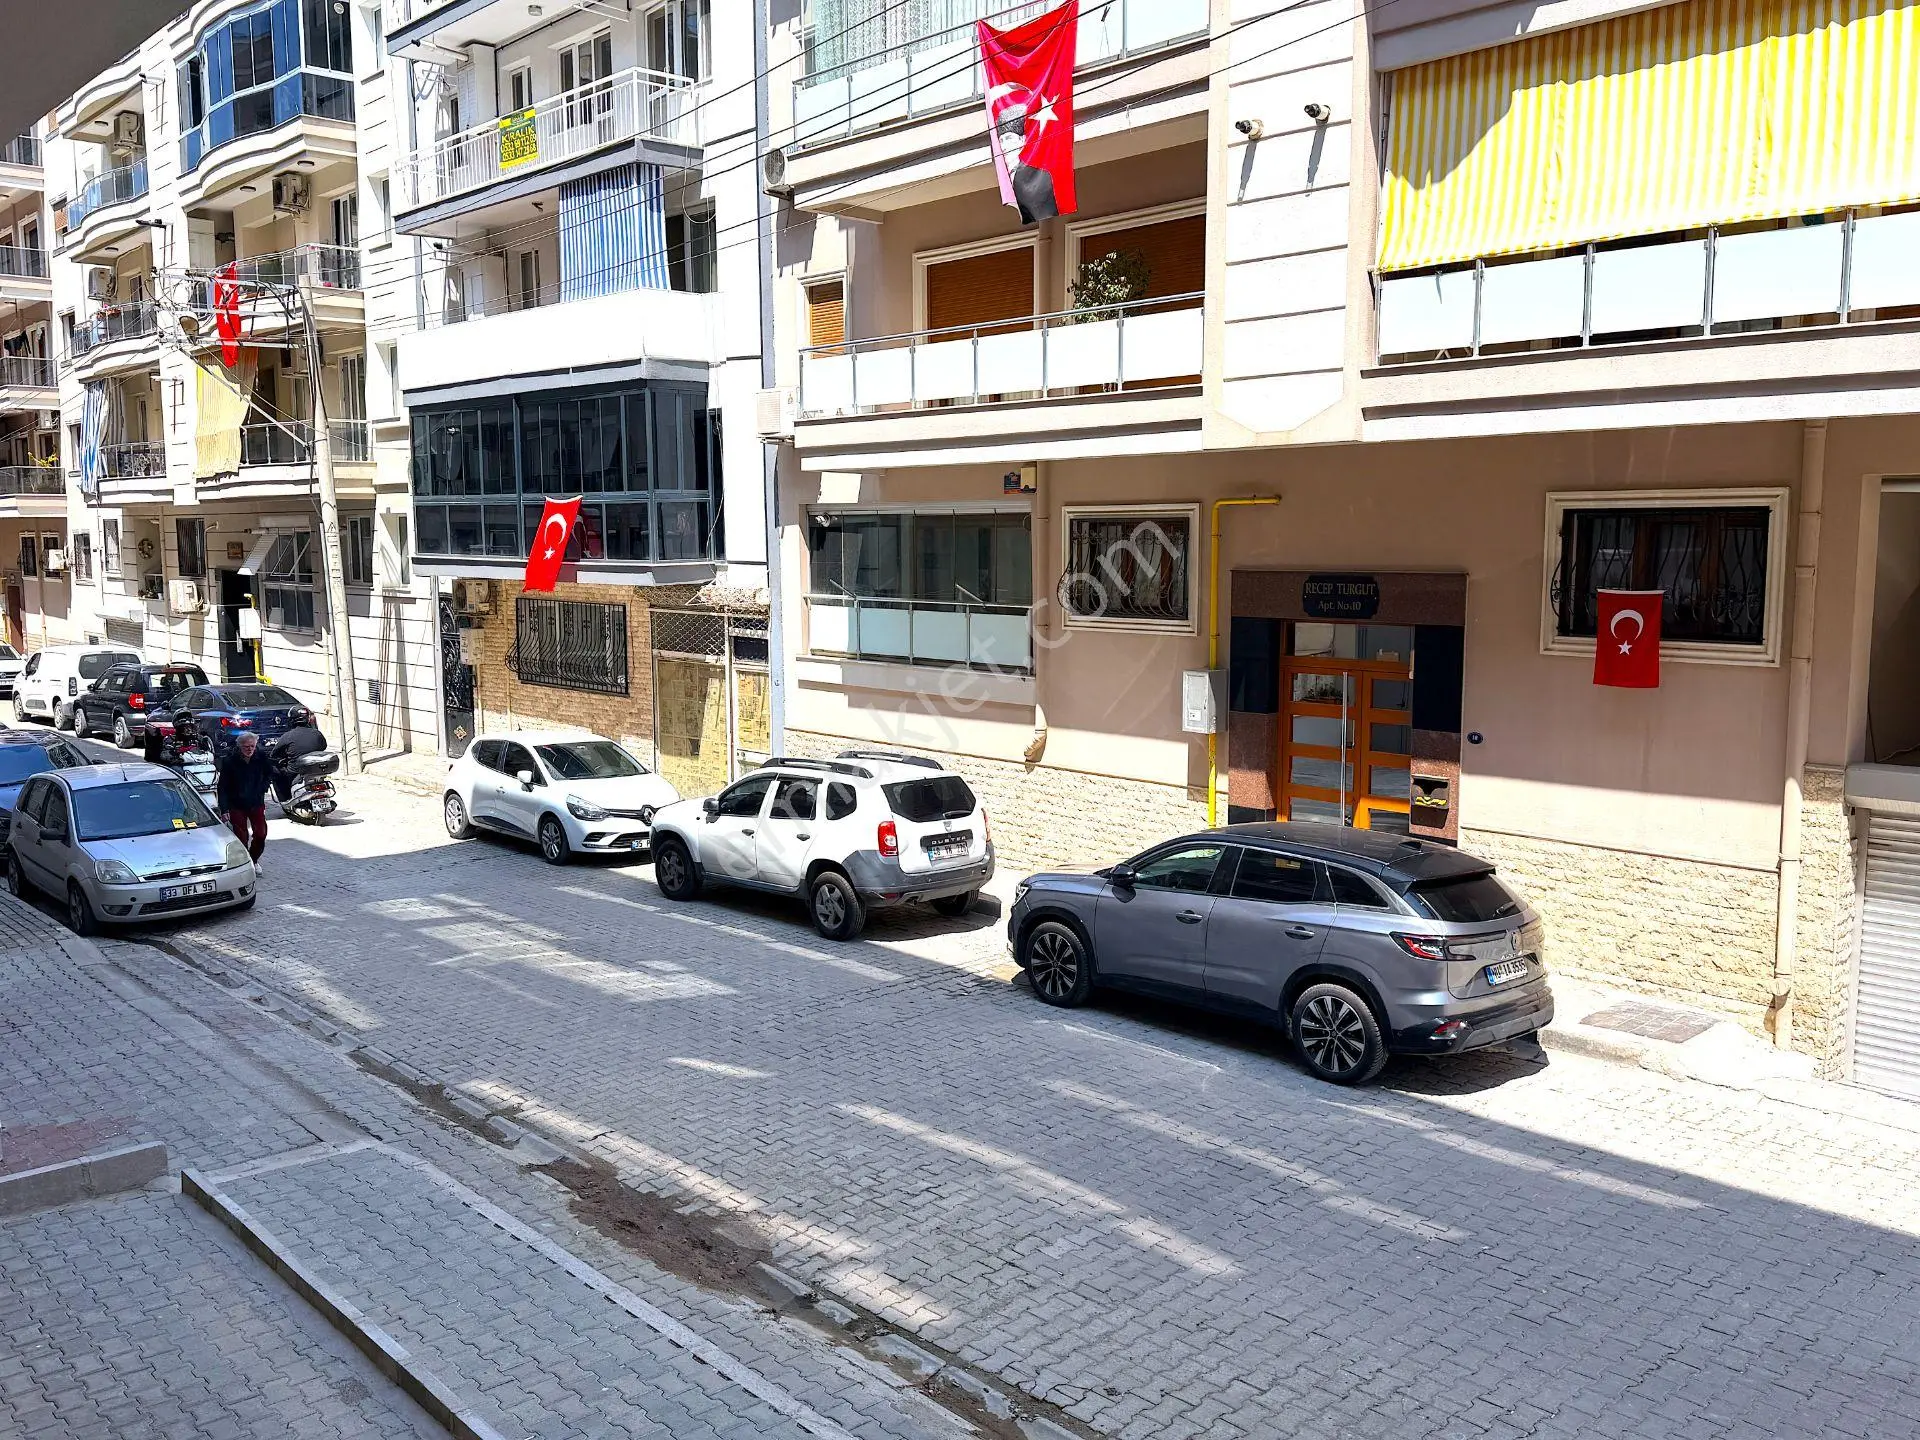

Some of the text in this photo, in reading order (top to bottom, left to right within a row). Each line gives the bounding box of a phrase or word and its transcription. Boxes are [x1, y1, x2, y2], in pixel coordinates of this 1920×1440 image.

[1305, 583, 1376, 595] RECEP TURGUT
[931, 836, 966, 844] DUSTER
[166, 882, 213, 897] 33 DFA 95
